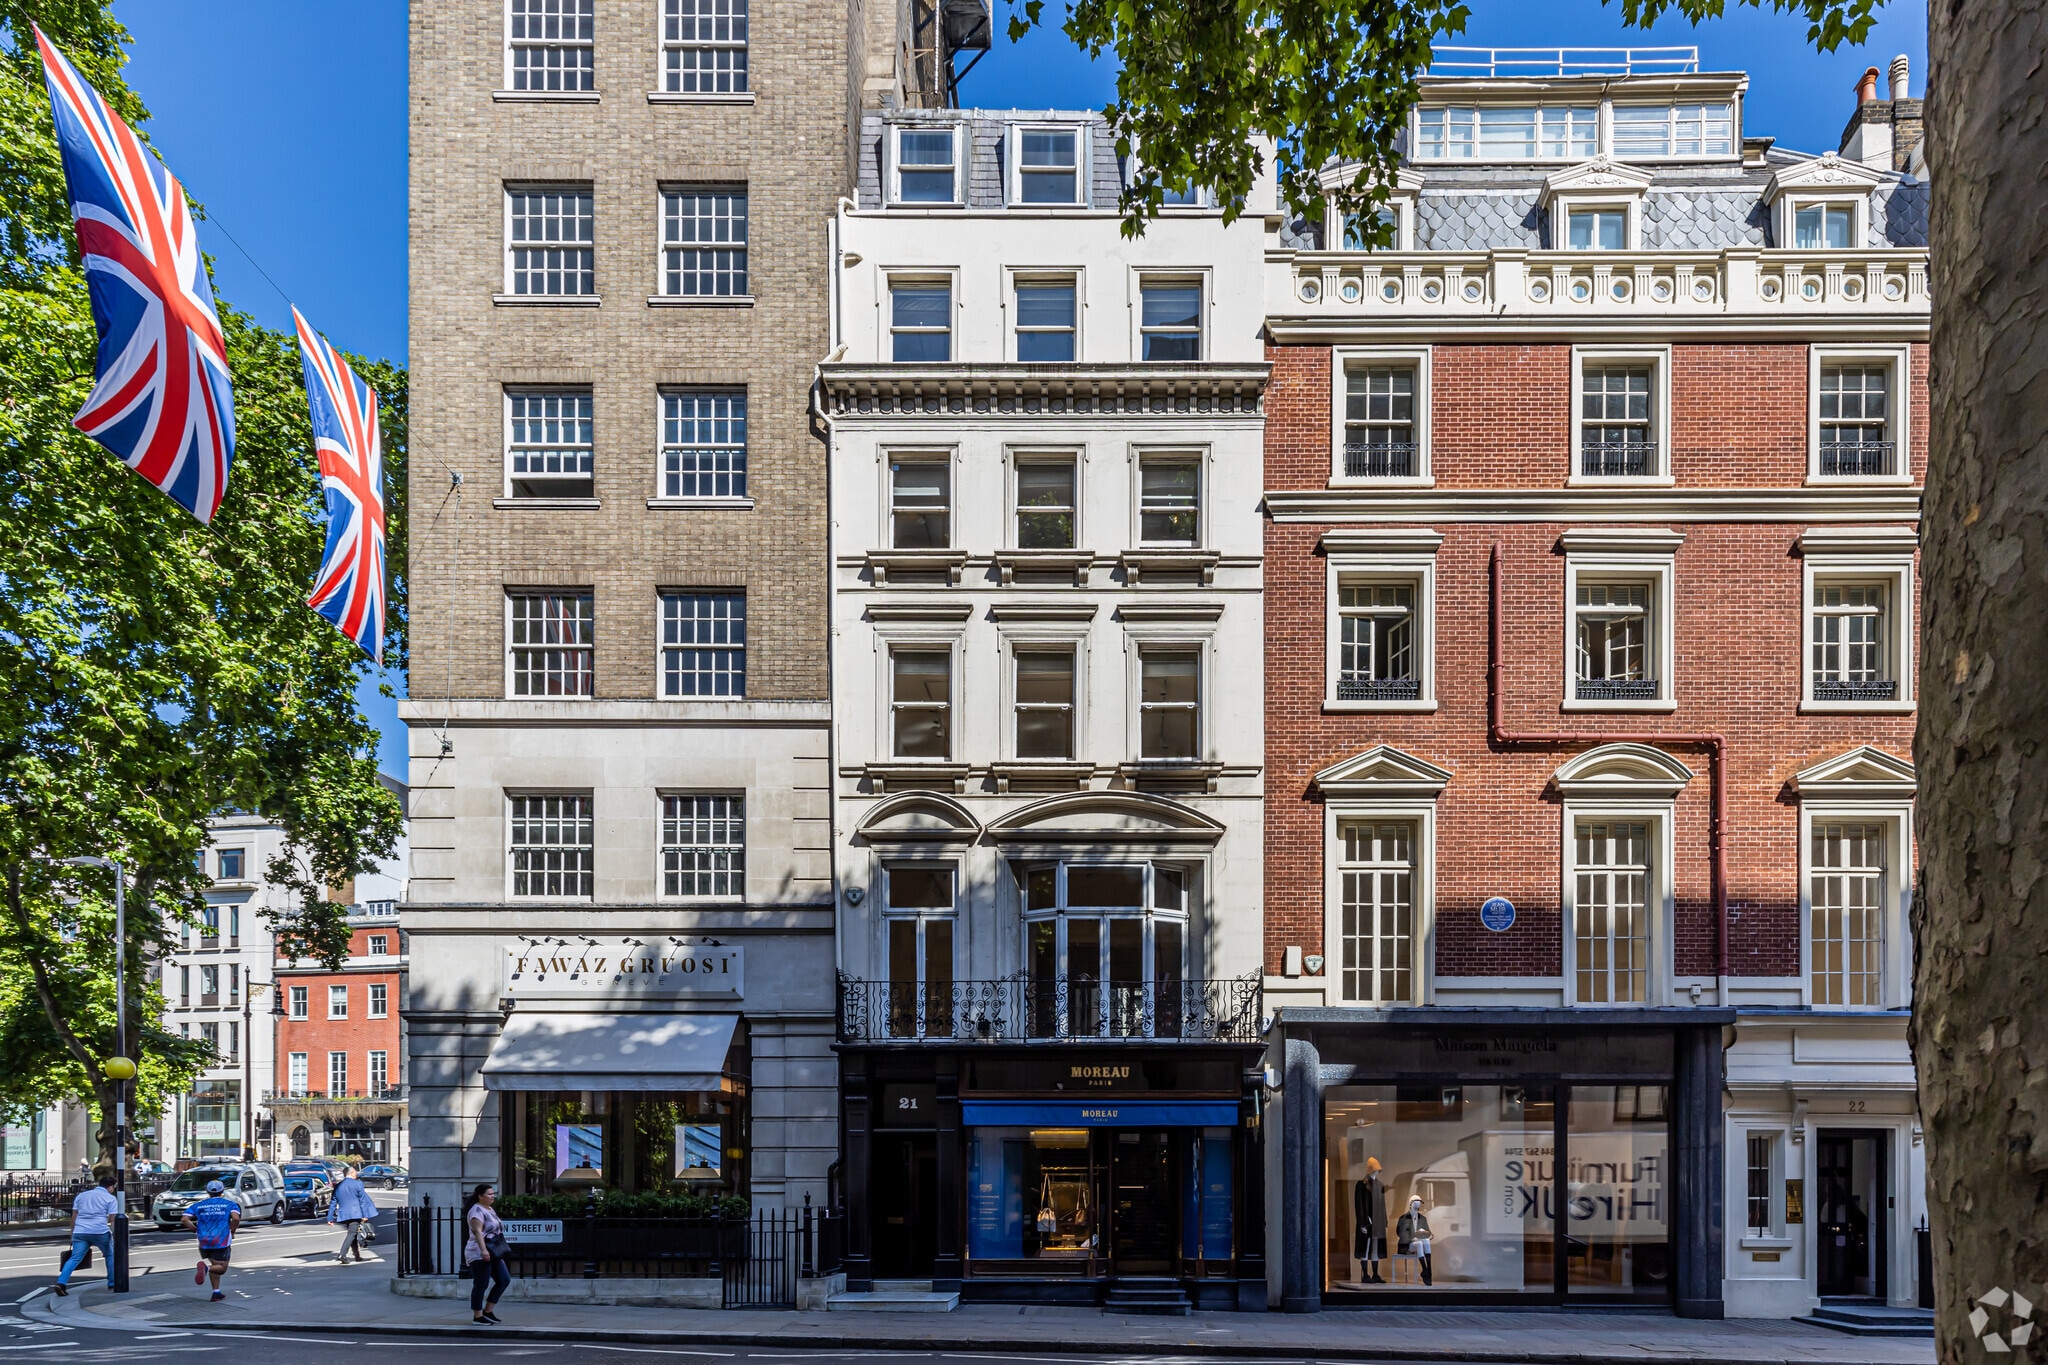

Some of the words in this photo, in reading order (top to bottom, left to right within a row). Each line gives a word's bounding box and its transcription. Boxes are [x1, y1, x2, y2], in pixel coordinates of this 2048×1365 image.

[517, 957, 607, 973] FAWAZ
[620, 957, 729, 973] GRUOSI
[1071, 1066, 1130, 1078] MOREAU
[899, 1097, 918, 1109] 21
[1849, 1101, 1866, 1112] 22
[1082, 1110, 1118, 1118] MOREAU
[511, 1224, 543, 1233] STREET
[544, 1224, 557, 1233] W1
